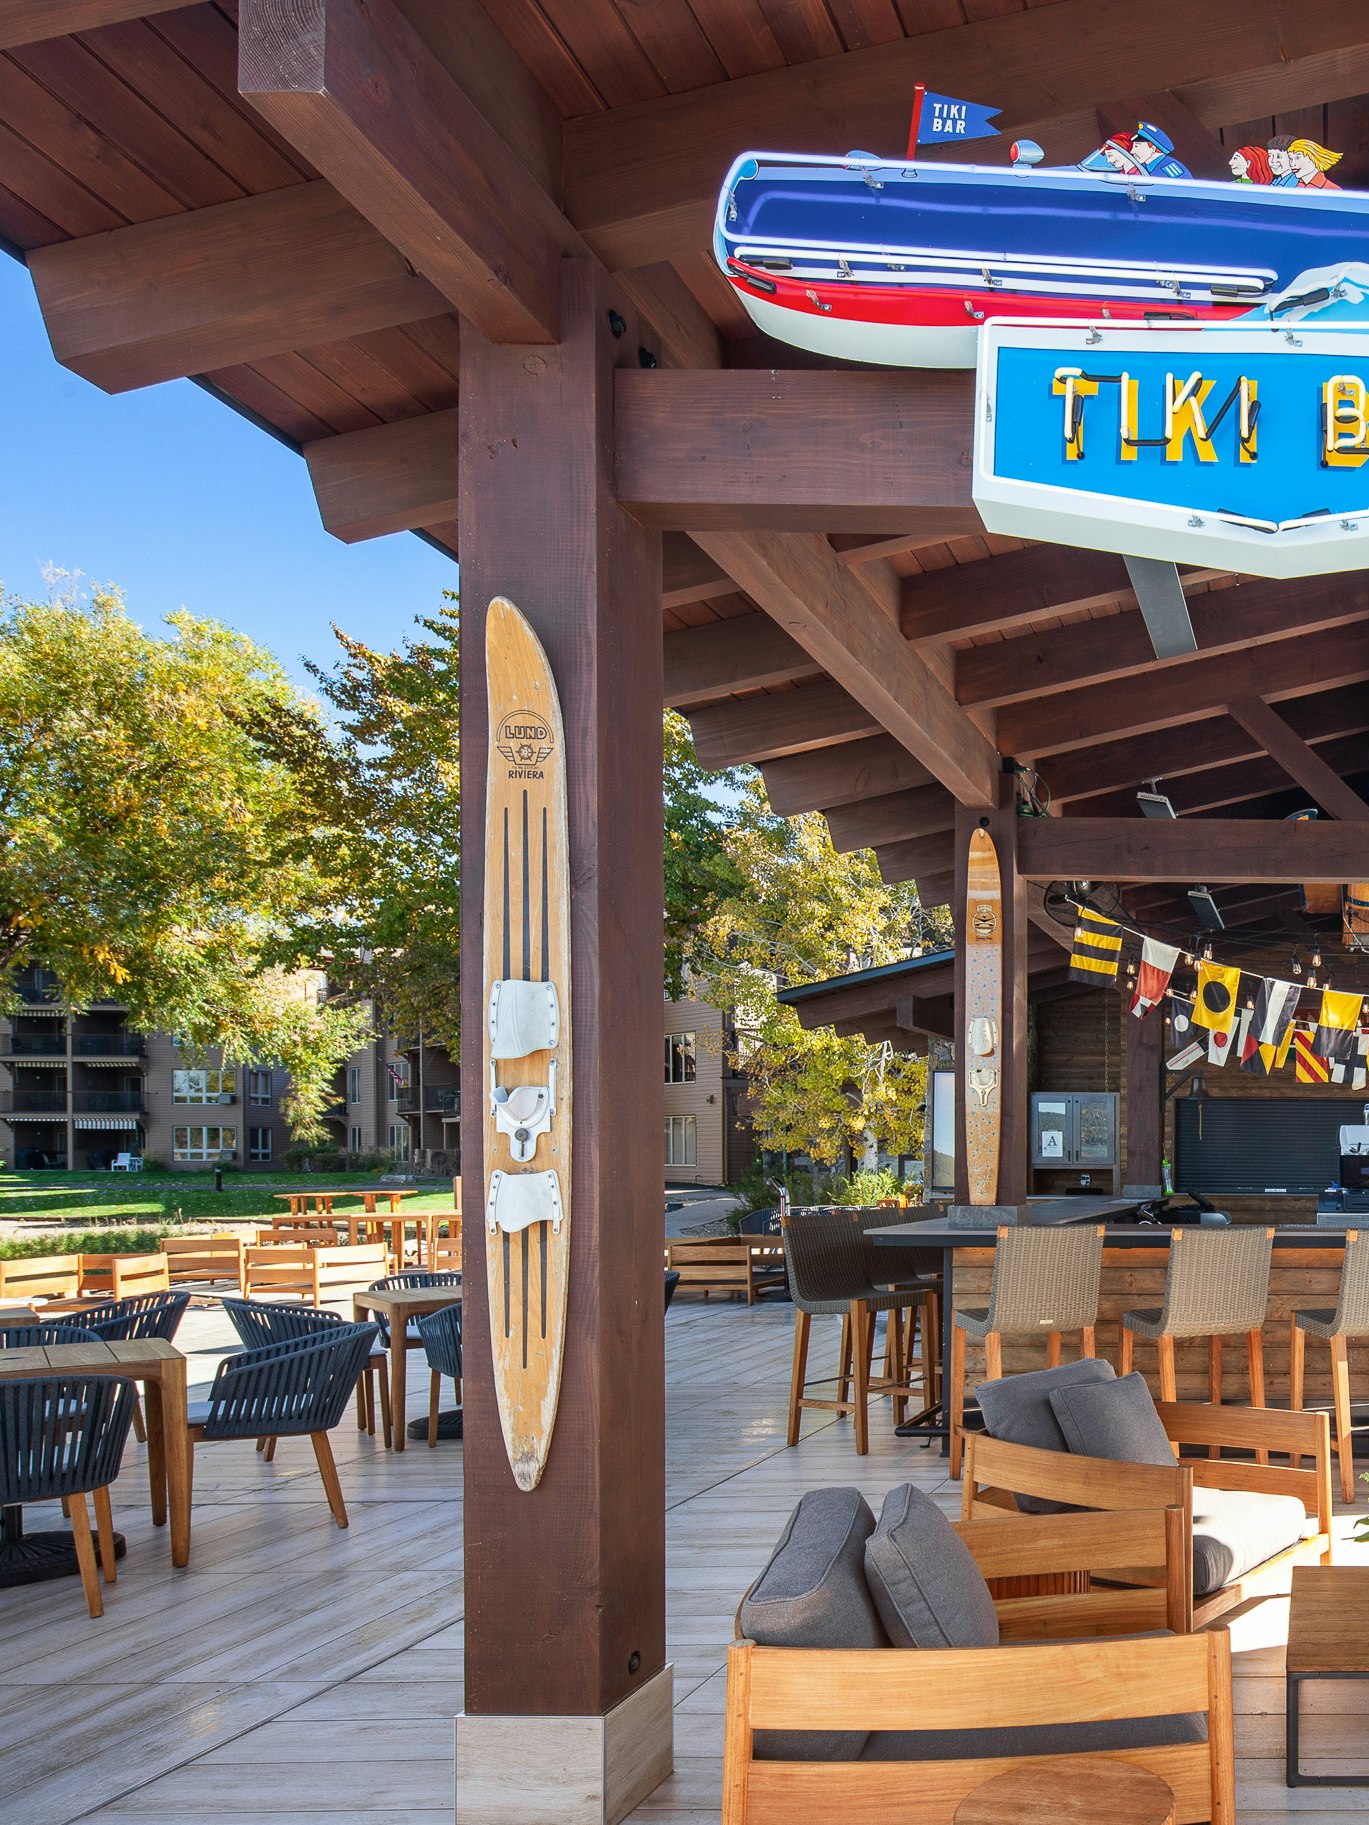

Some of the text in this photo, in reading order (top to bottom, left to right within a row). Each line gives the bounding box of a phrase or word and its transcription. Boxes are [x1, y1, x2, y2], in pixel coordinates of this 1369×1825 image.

[933, 103, 967, 119] TIKI
[932, 118, 966, 134] BAR
[1053, 367, 1259, 463] TIKI
[505, 725, 548, 739] LUND
[508, 769, 544, 779] RIVIERA
[1047, 1135, 1058, 1146] A
